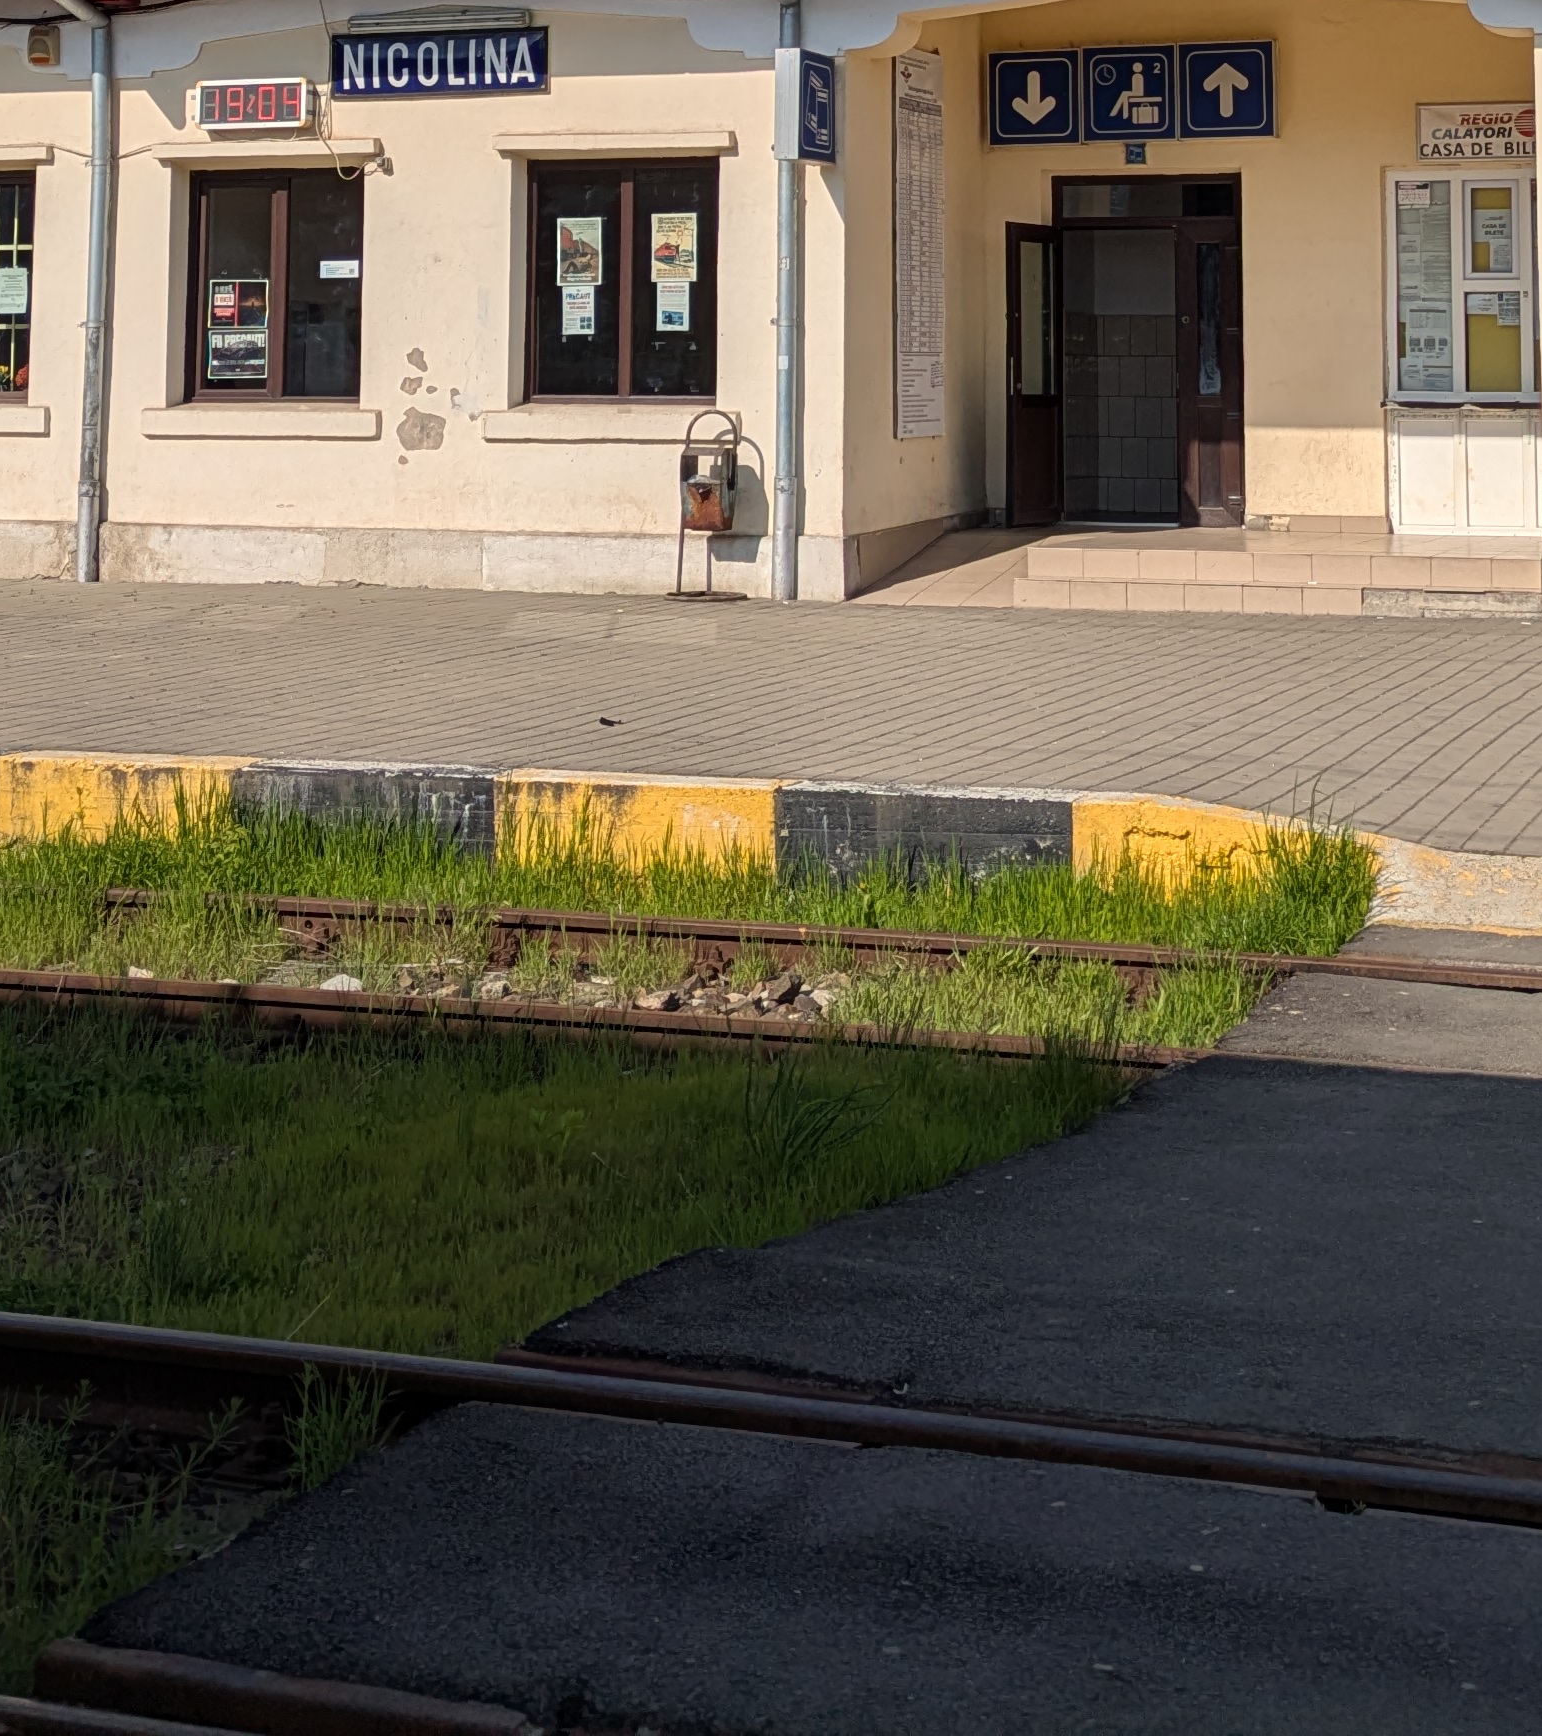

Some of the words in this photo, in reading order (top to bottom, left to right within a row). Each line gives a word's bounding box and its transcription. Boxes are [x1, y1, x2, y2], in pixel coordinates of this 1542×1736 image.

[343, 36, 537, 90] NICOLINA
[1153, 62, 1161, 74] 2
[211, 84, 302, 121] 19:04
[1419, 143, 1465, 157] CASA
[1471, 142, 1493, 156] DE
